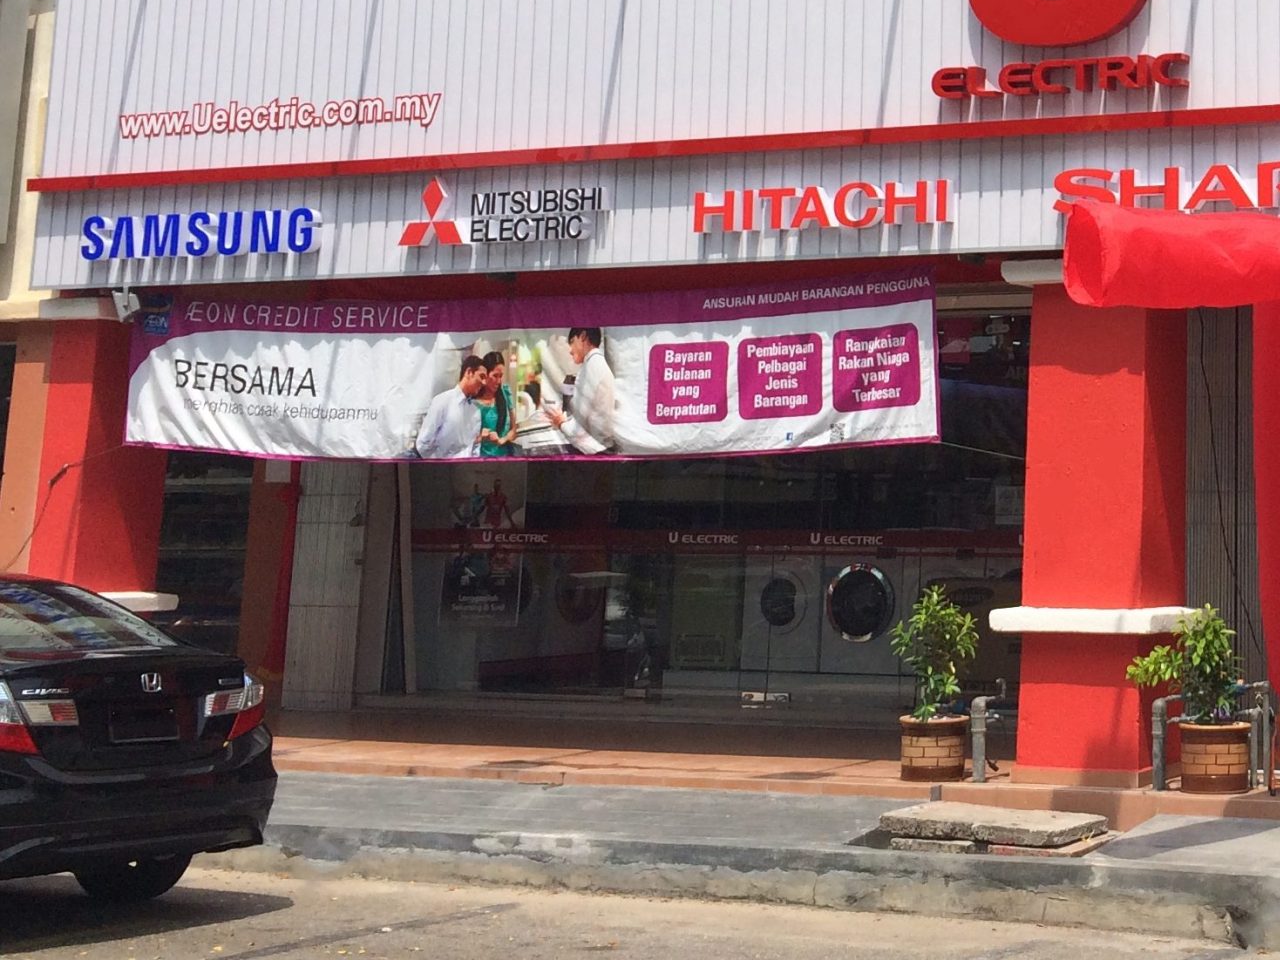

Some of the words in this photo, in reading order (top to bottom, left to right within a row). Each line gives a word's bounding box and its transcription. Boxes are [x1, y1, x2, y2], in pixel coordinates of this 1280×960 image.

[931, 53, 1190, 101] ELECTRIC
[119, 91, 441, 139] www.Uelectric.com.my
[471, 187, 602, 217] MITSUBISHI
[693, 179, 951, 233] HITACHI
[81, 206, 316, 261] SAMSUNG
[470, 214, 584, 243] ELECTRIC
[703, 294, 755, 310] ANSURAN
[758, 290, 799, 305] MUDAH
[802, 283, 864, 301] BARANGAN
[866, 276, 930, 295] PENGGUNA
[243, 304, 323, 328] CREDIT
[331, 306, 429, 328] SERVICE
[747, 342, 814, 359] Pembiayaan
[845, 335, 906, 354] Rangkaian
[665, 350, 712, 365] Bayaran
[838, 356, 874, 371] Rakan
[877, 351, 910, 368] Niaga
[664, 367, 711, 382] Bulanan
[757, 358, 807, 375] Pelbagai
[174, 359, 317, 397] BERSAMA
[765, 376, 798, 390] Jenis
[861, 370, 891, 386] yang
[672, 384, 700, 400] yang
[852, 387, 902, 403] Terbesar
[754, 393, 808, 409] Barangan
[656, 402, 717, 420] Berpatutan
[482, 530, 492, 543] U
[495, 533, 549, 544] ELECTRIC
[668, 531, 679, 544] U
[682, 534, 738, 545] ELECTRIC
[810, 532, 821, 545] U
[824, 535, 884, 546] ELECTRIC
[21, 687, 70, 696] CIVIC
